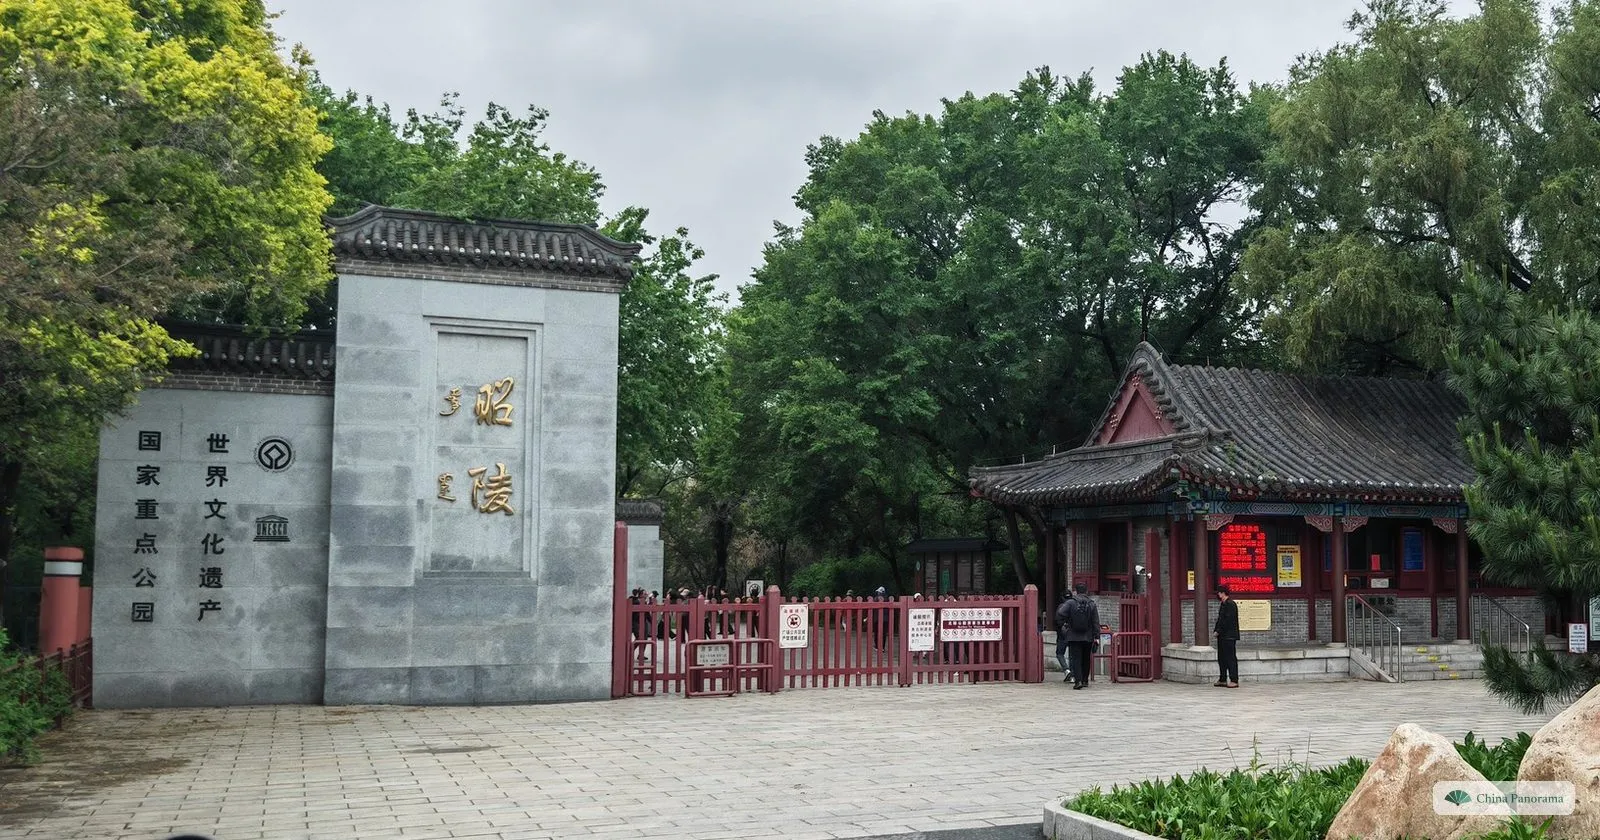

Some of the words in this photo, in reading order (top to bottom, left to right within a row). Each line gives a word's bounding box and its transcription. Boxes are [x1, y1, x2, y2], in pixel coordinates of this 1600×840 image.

[131, 431, 161, 622] 国家重点公园
[197, 433, 230, 622] 世界文化遗产
[468, 376, 514, 516] 昭陵
[256, 523, 288, 536] UNESCO
